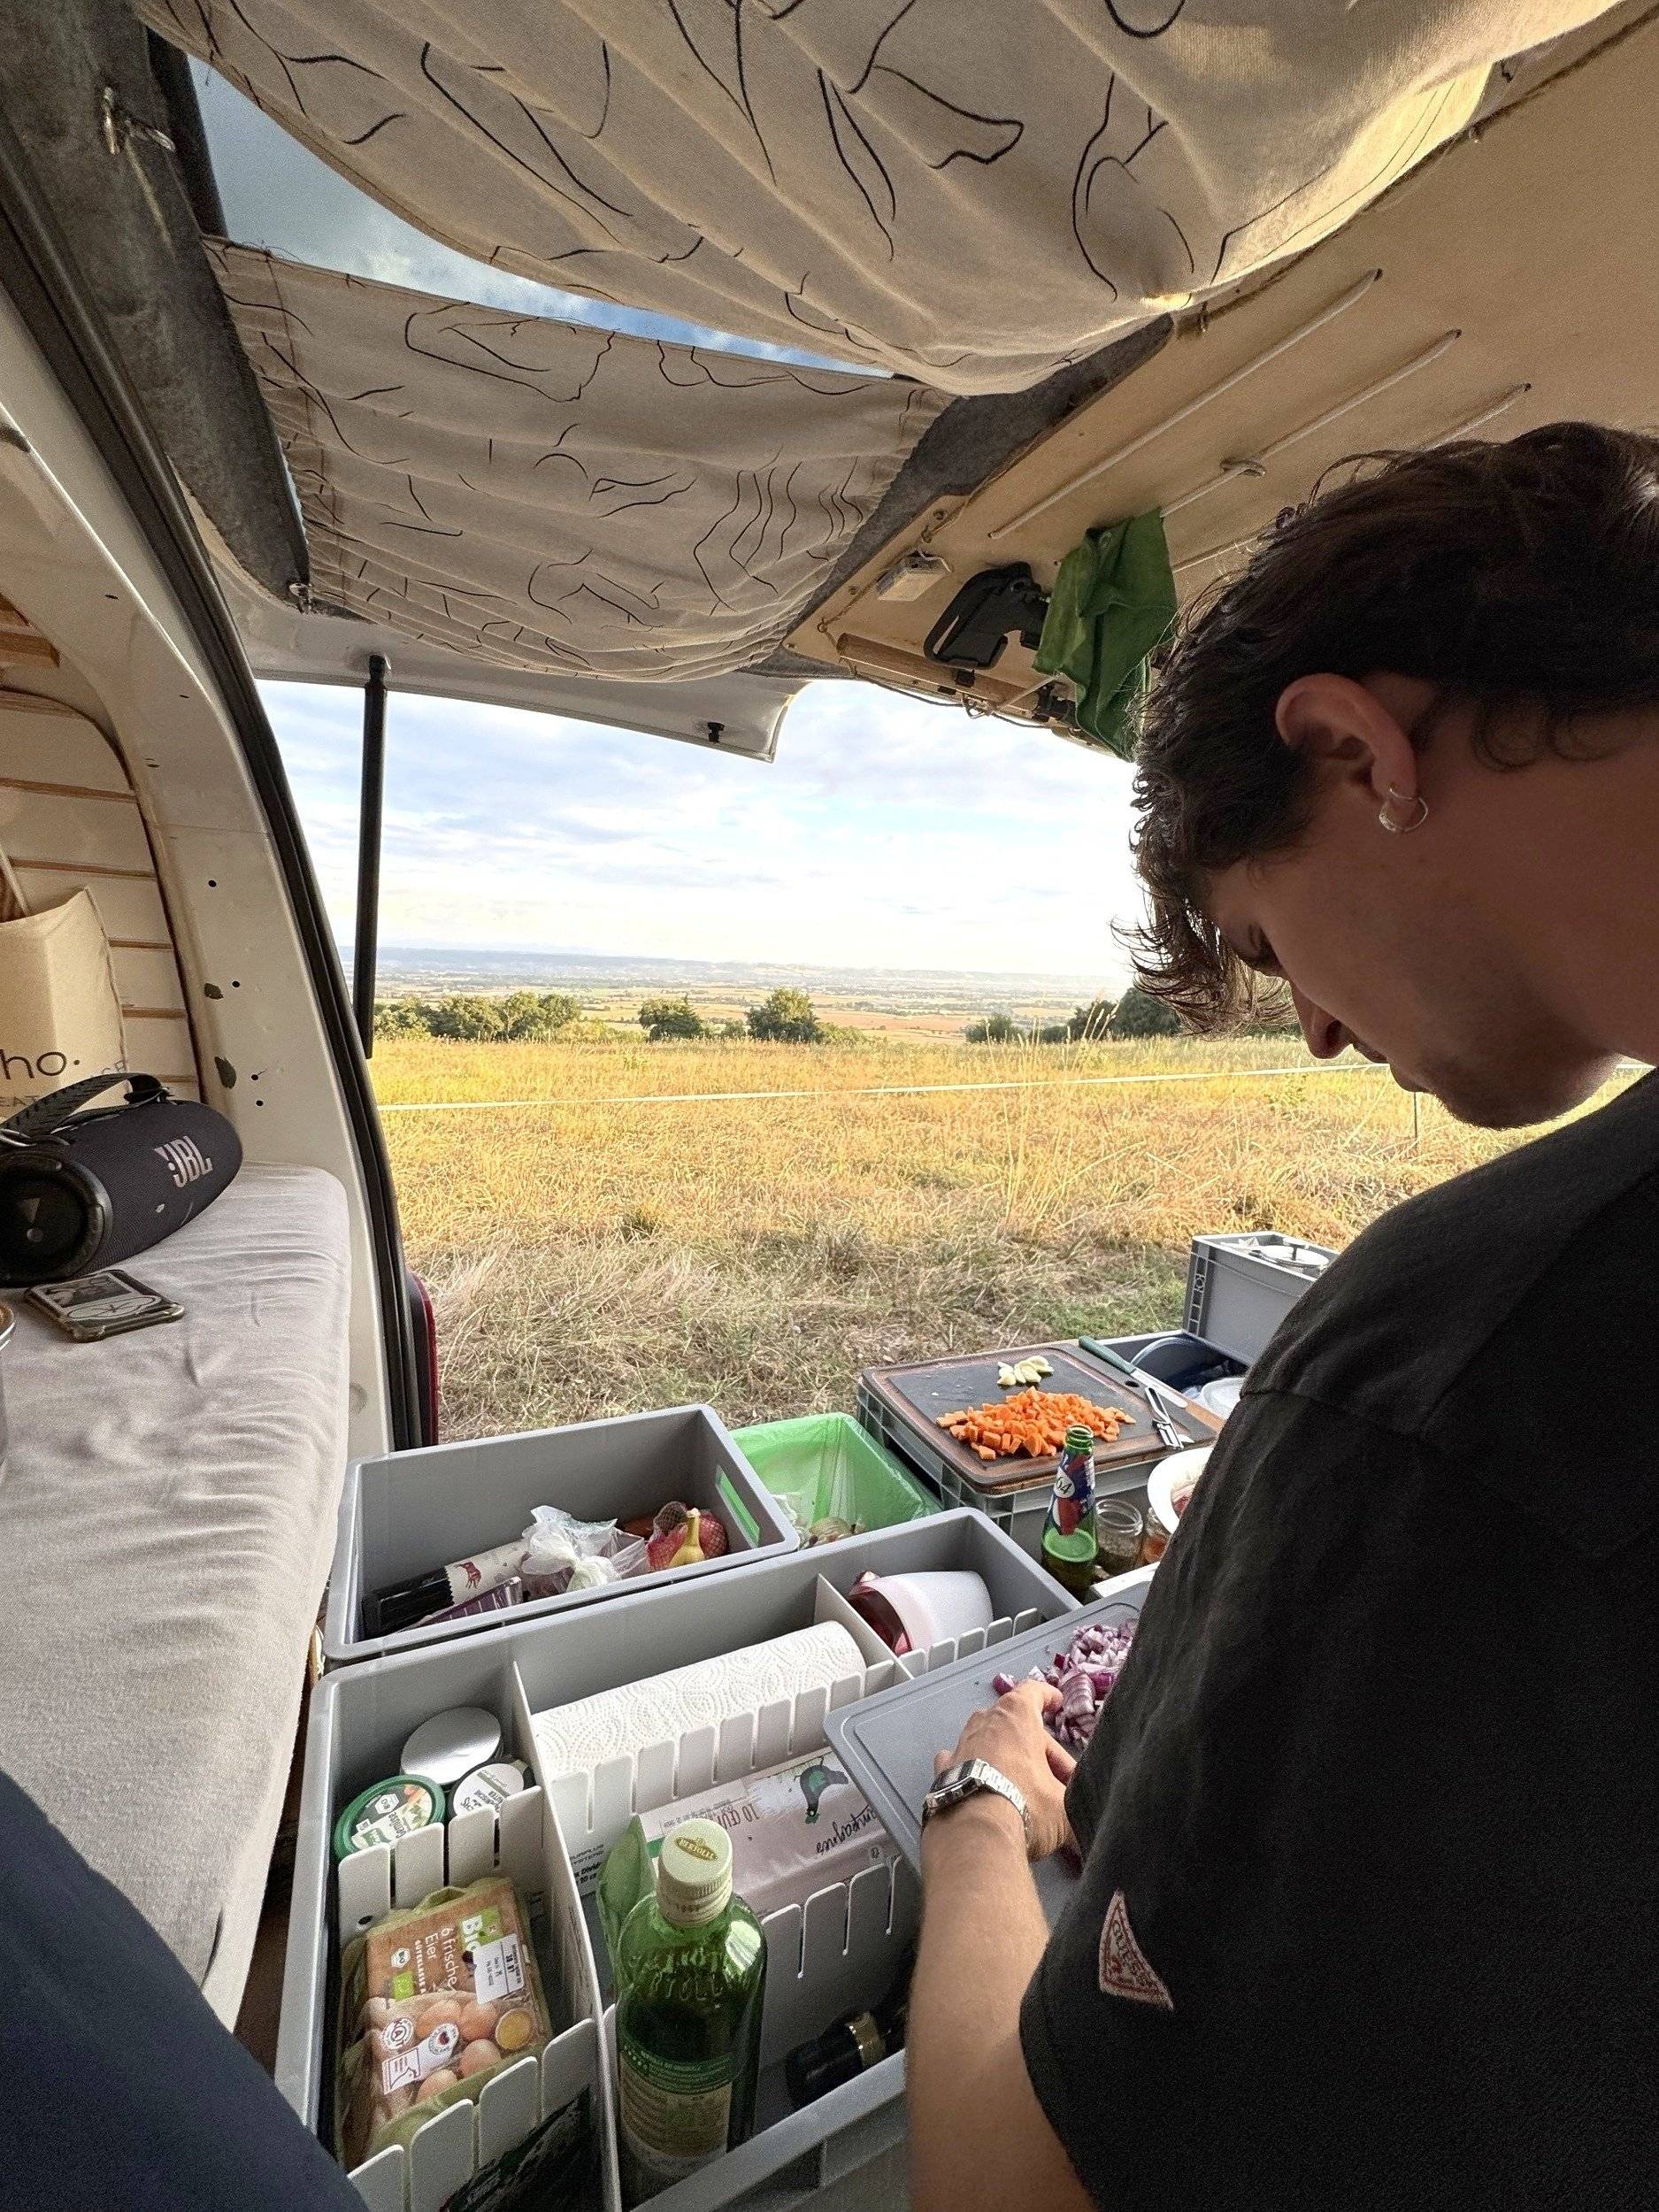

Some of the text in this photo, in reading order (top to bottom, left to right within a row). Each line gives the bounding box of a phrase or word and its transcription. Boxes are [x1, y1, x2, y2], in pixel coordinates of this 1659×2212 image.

[155, 1136, 213, 1187] JBL
[388, 1812, 407, 1839] Gemüse
[742, 1803, 759, 1823] 10
[425, 1932, 439, 1961] Eier
[441, 1927, 458, 1987] 6 frische
